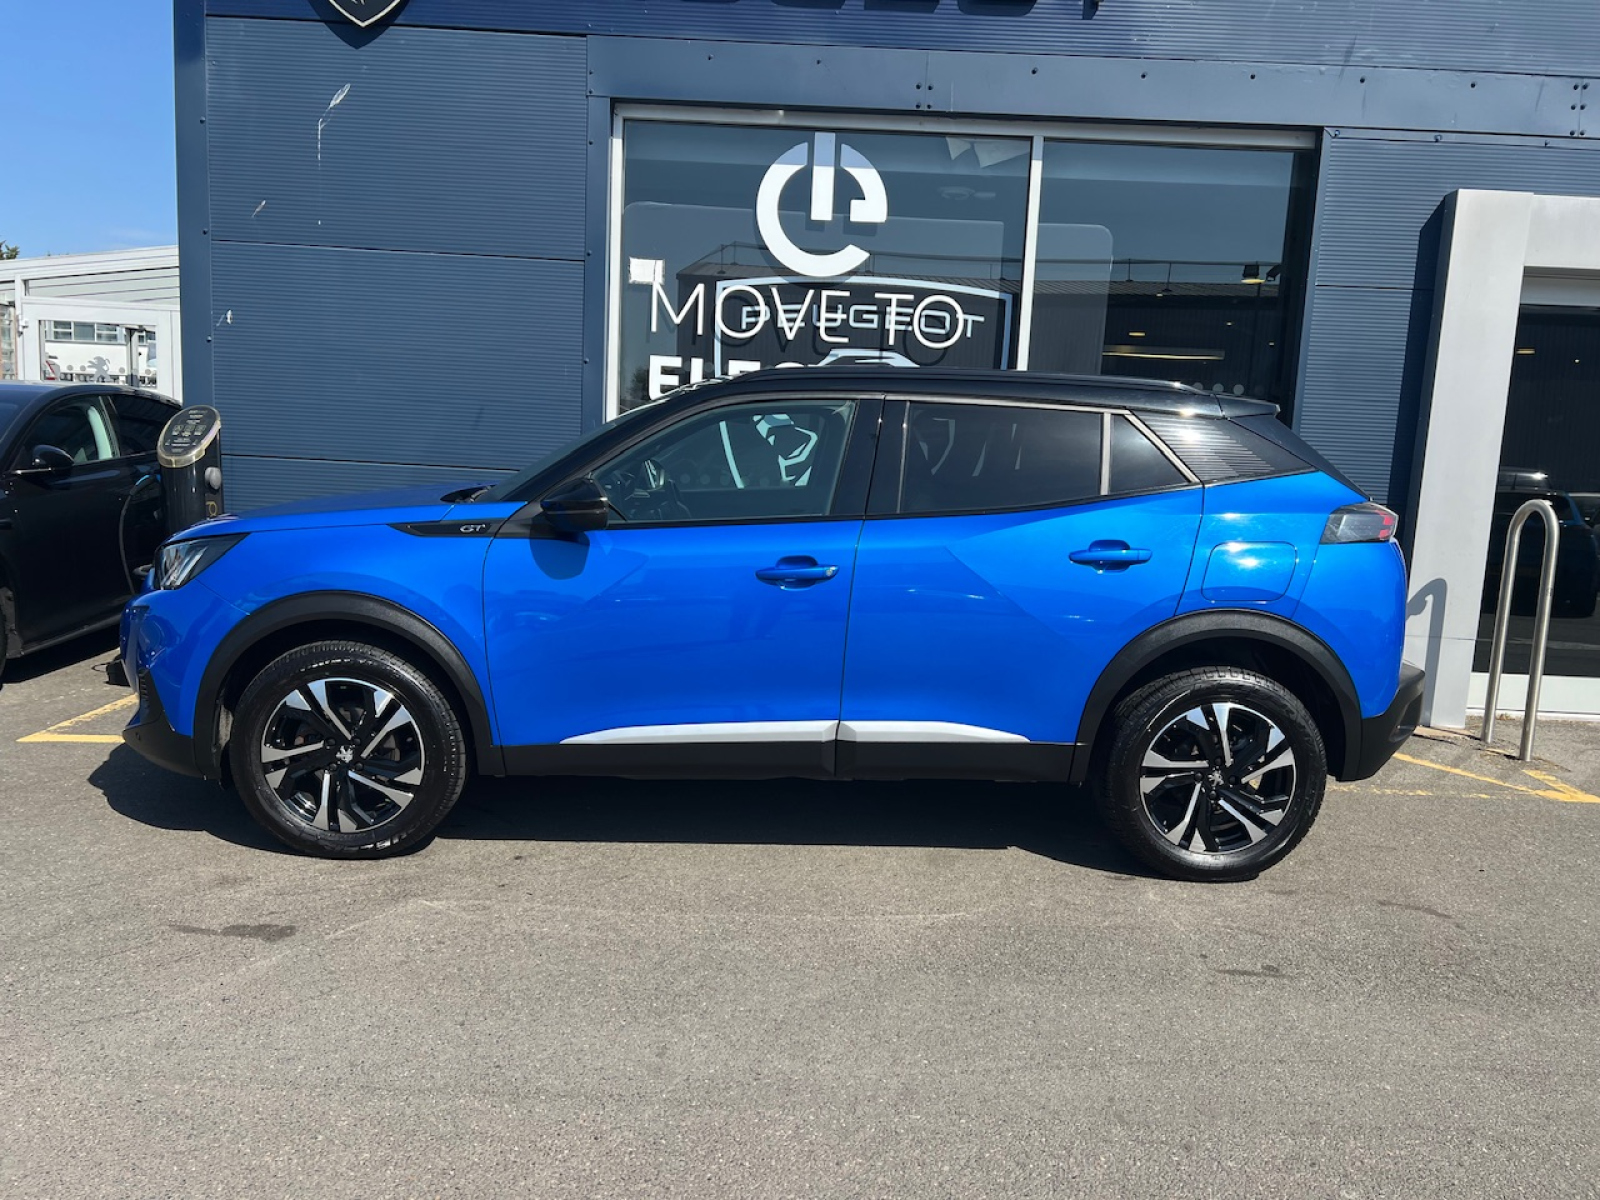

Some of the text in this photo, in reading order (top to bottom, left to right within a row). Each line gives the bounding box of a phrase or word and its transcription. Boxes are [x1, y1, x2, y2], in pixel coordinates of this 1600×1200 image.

[650, 281, 964, 349] MOVE TO
[740, 303, 985, 338] PEUGEOT
[459, 523, 486, 533] GT
